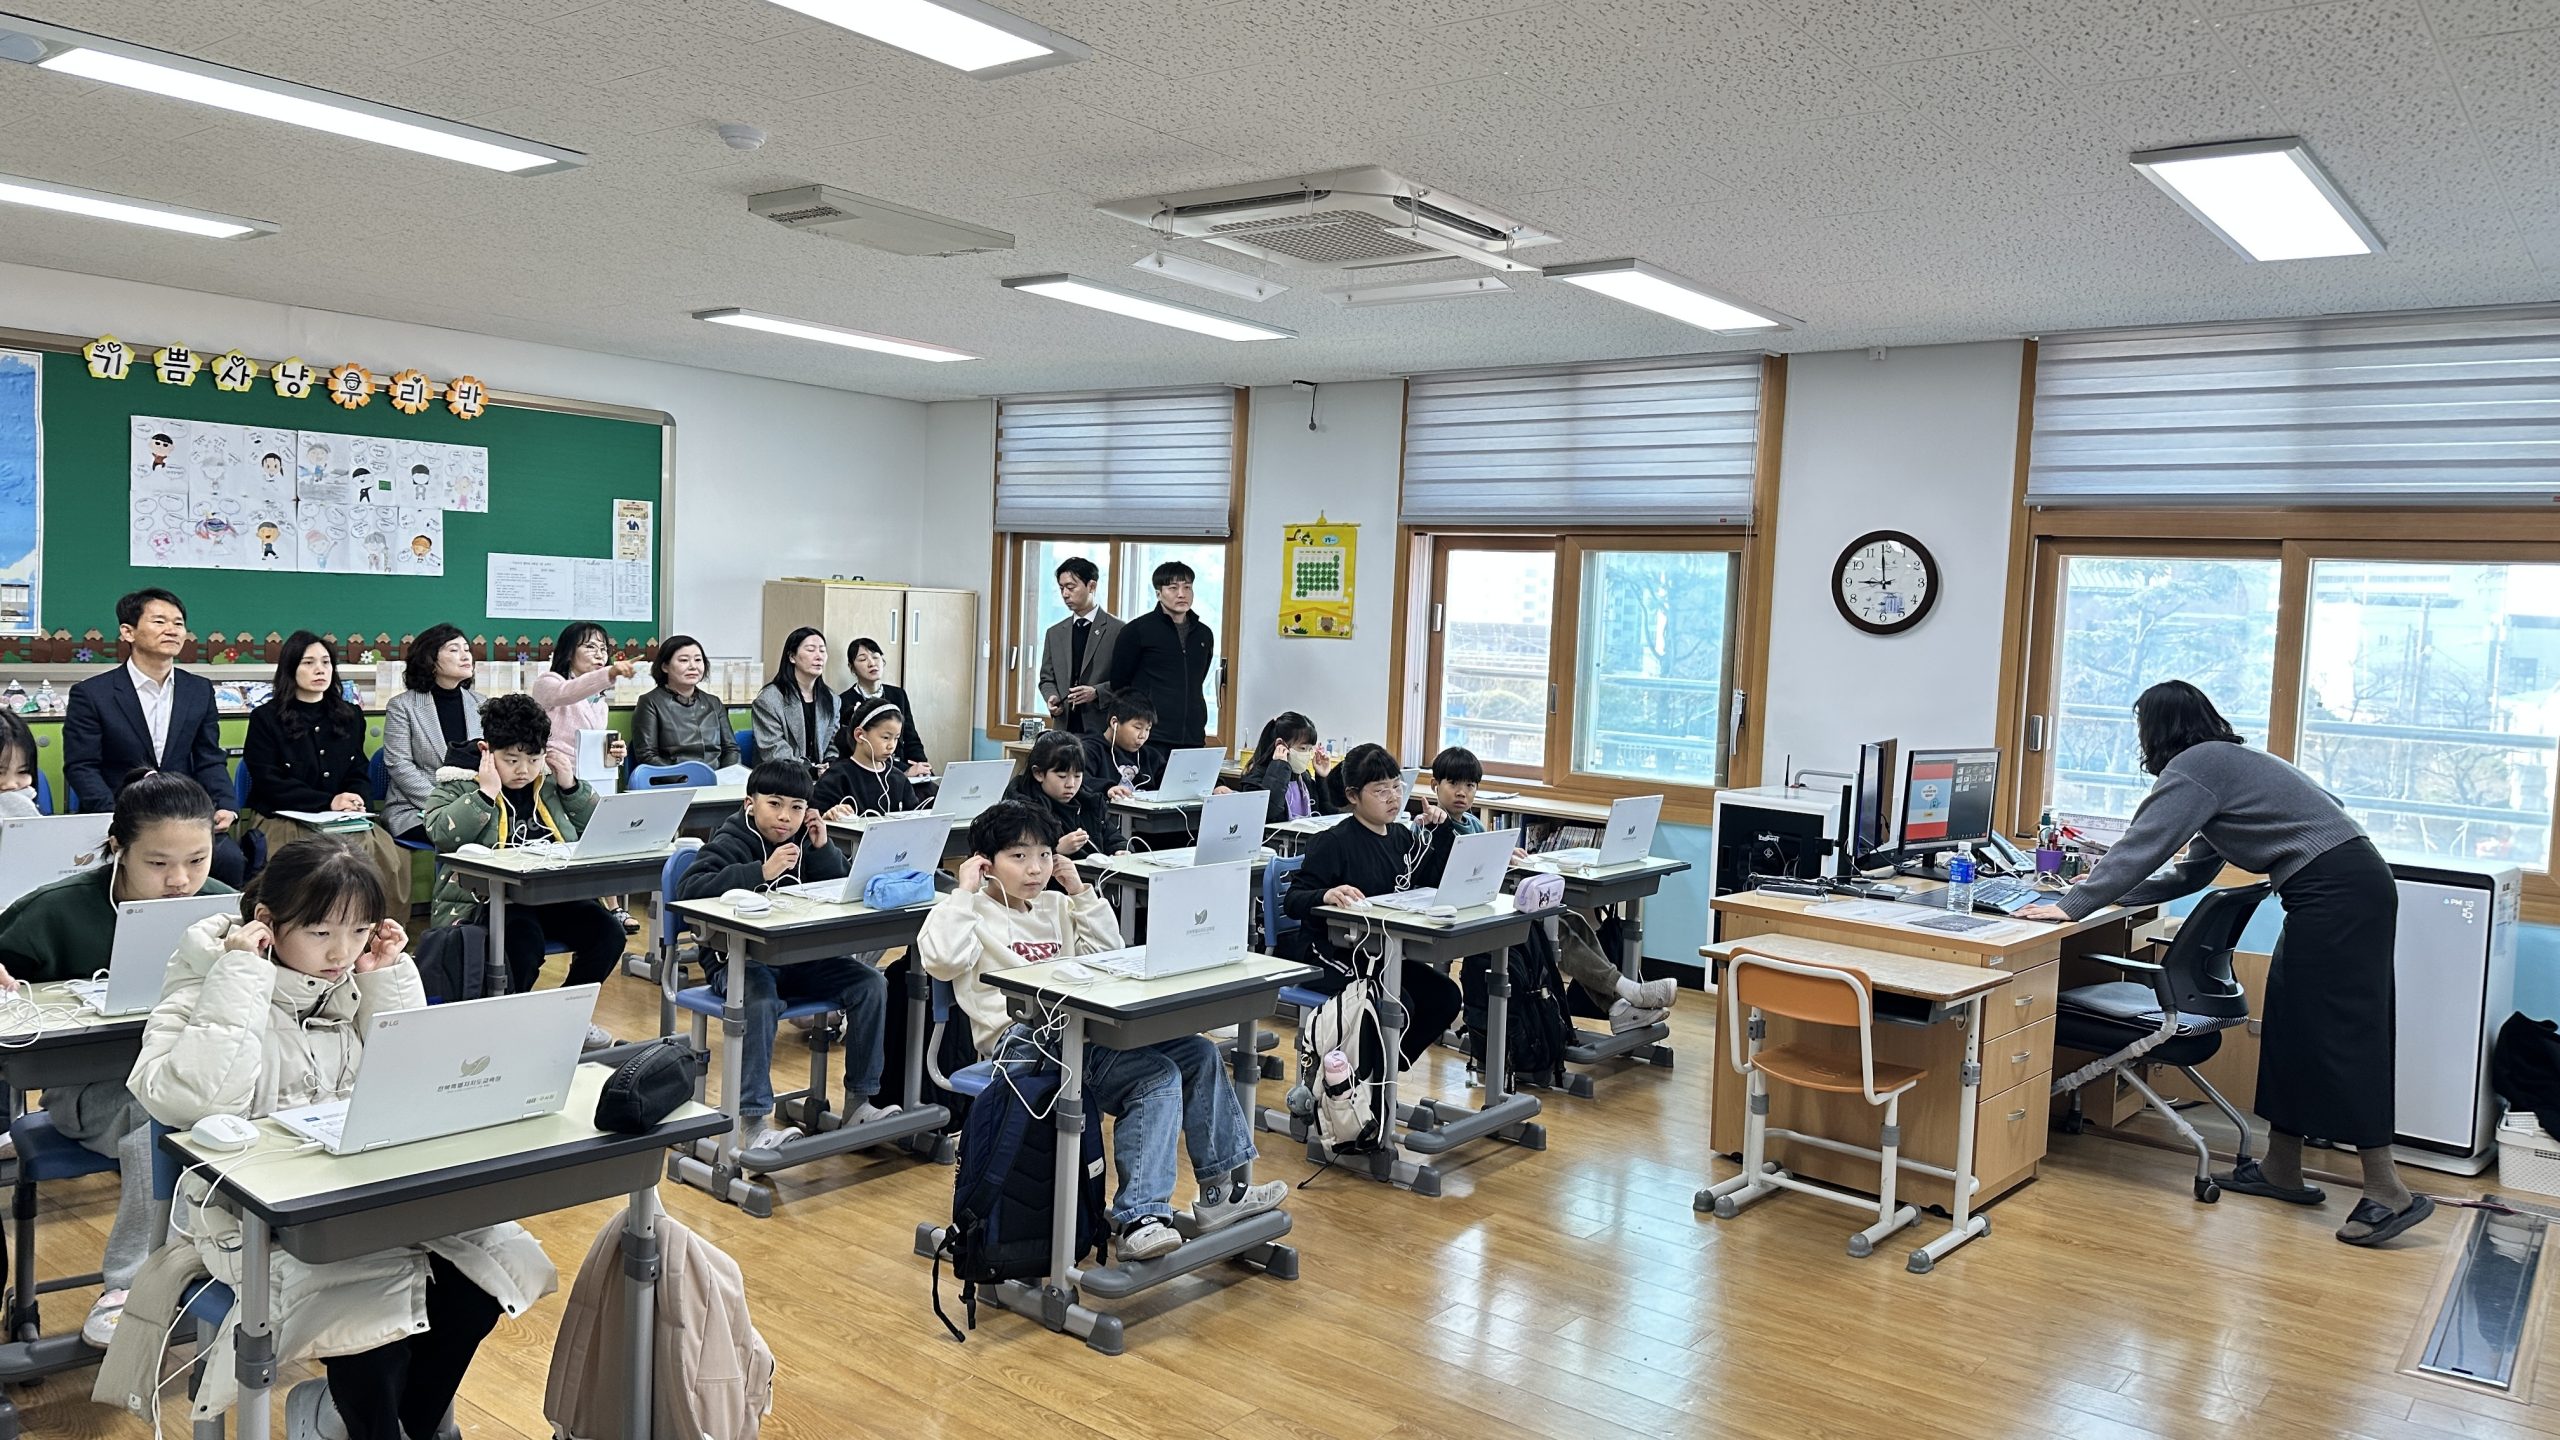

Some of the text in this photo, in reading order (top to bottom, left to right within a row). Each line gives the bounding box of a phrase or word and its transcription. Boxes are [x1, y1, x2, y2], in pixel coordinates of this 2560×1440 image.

[1866, 548, 1875, 558] 11
[1853, 560, 1864, 570] 10
[1914, 561, 1920, 570] 2
[1845, 577, 1852, 587] 9
[1918, 578, 1925, 588] 3
[1850, 594, 1857, 603] 8
[1911, 595, 1918, 604] 4
[1863, 607, 1870, 617] 7
[1879, 612, 1887, 622] 6
[1898, 608, 1905, 617] 5
